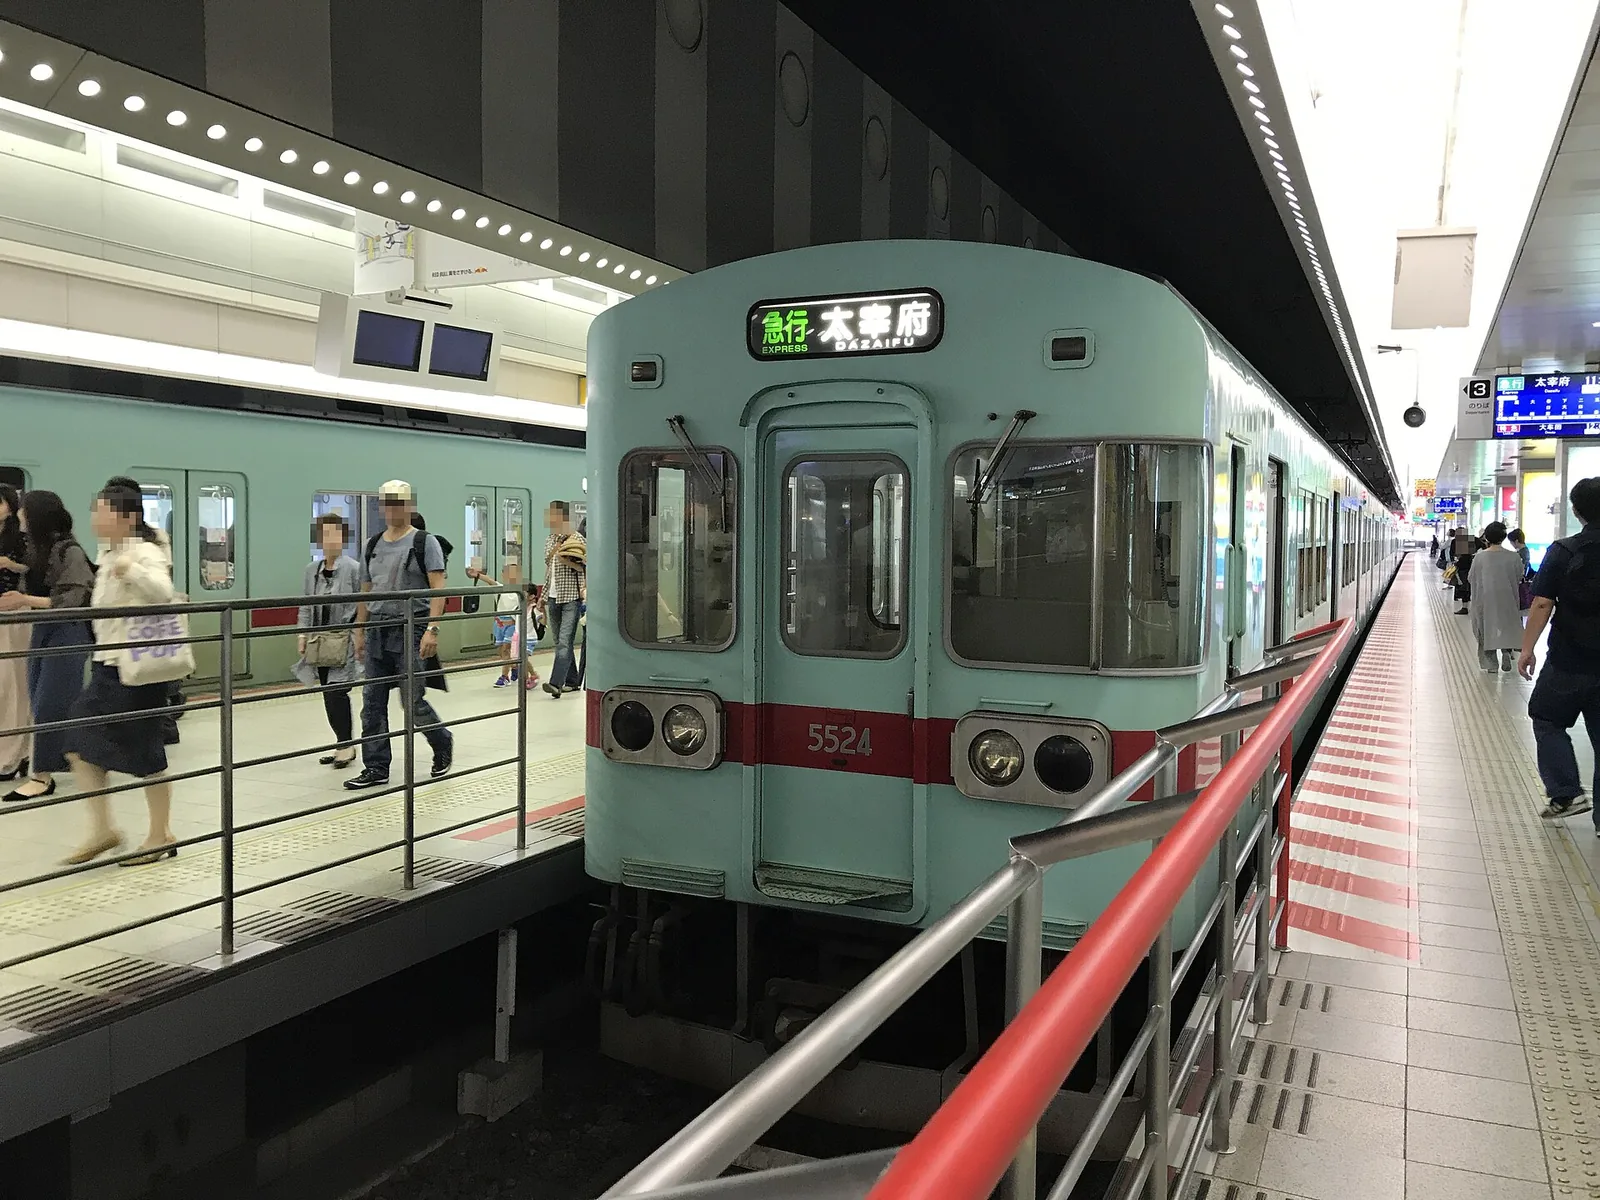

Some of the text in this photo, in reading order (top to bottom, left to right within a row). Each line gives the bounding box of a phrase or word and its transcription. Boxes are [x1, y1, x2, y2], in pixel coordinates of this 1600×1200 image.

[762, 301, 930, 344] 急行 太宰府
[762, 344, 808, 354] EXPRESS
[835, 337, 915, 351] DAZAIFU
[1473, 382, 1487, 396] 3
[1535, 376, 1570, 388] 太宰府
[808, 723, 873, 756] 5524
